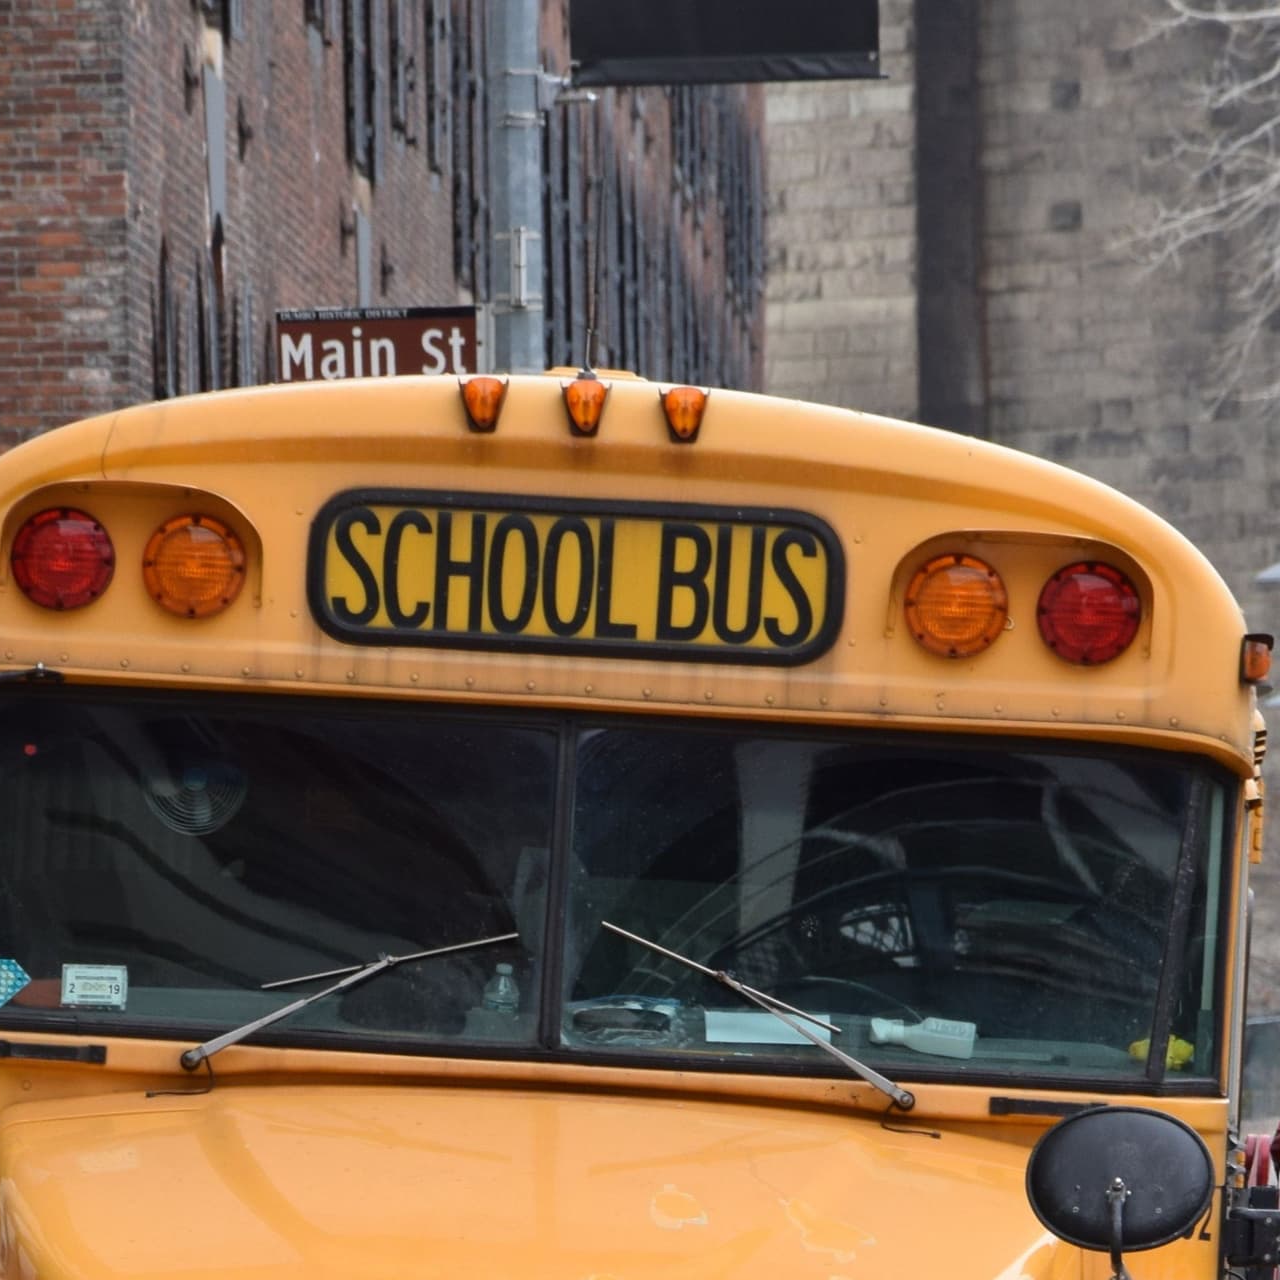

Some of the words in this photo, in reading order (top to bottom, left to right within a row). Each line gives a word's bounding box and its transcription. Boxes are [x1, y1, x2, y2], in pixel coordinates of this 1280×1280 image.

[280, 326, 397, 380] Main
[421, 326, 468, 375] St
[331, 506, 638, 639] SCHOOL
[655, 521, 818, 648] BUS
